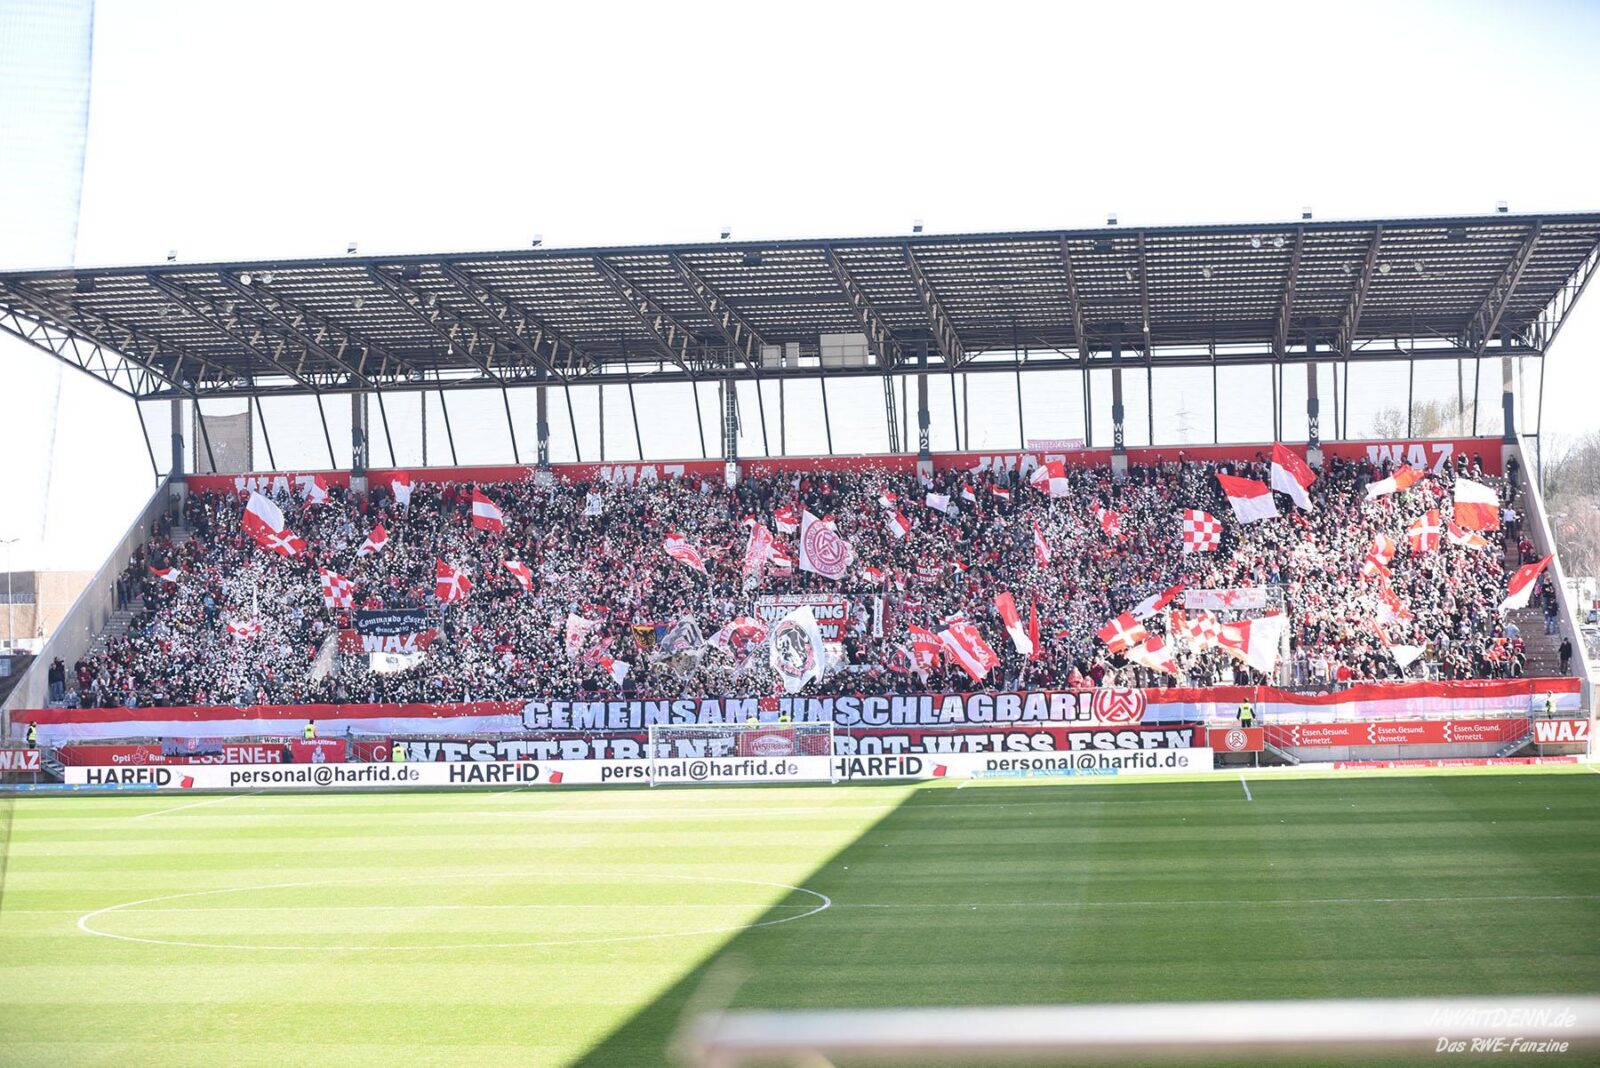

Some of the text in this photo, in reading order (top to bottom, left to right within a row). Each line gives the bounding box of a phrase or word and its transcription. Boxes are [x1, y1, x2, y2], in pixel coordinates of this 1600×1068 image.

[921, 439, 928, 449] 2
[1367, 444, 1455, 473] WAZ
[522, 699, 759, 730] GEMEINSAM
[1302, 737, 1332, 745] Vernetzt.
[1378, 734, 1408, 742] Vernetzt.
[1454, 733, 1484, 741] Vernetzt.
[1536, 721, 1589, 742] WAZ
[112, 754, 131, 764] Opti
[987, 752, 1190, 772] personal@harfid.de
[230, 764, 419, 787] personal@harfid.de
[601, 759, 799, 784] personal@harfid.de
